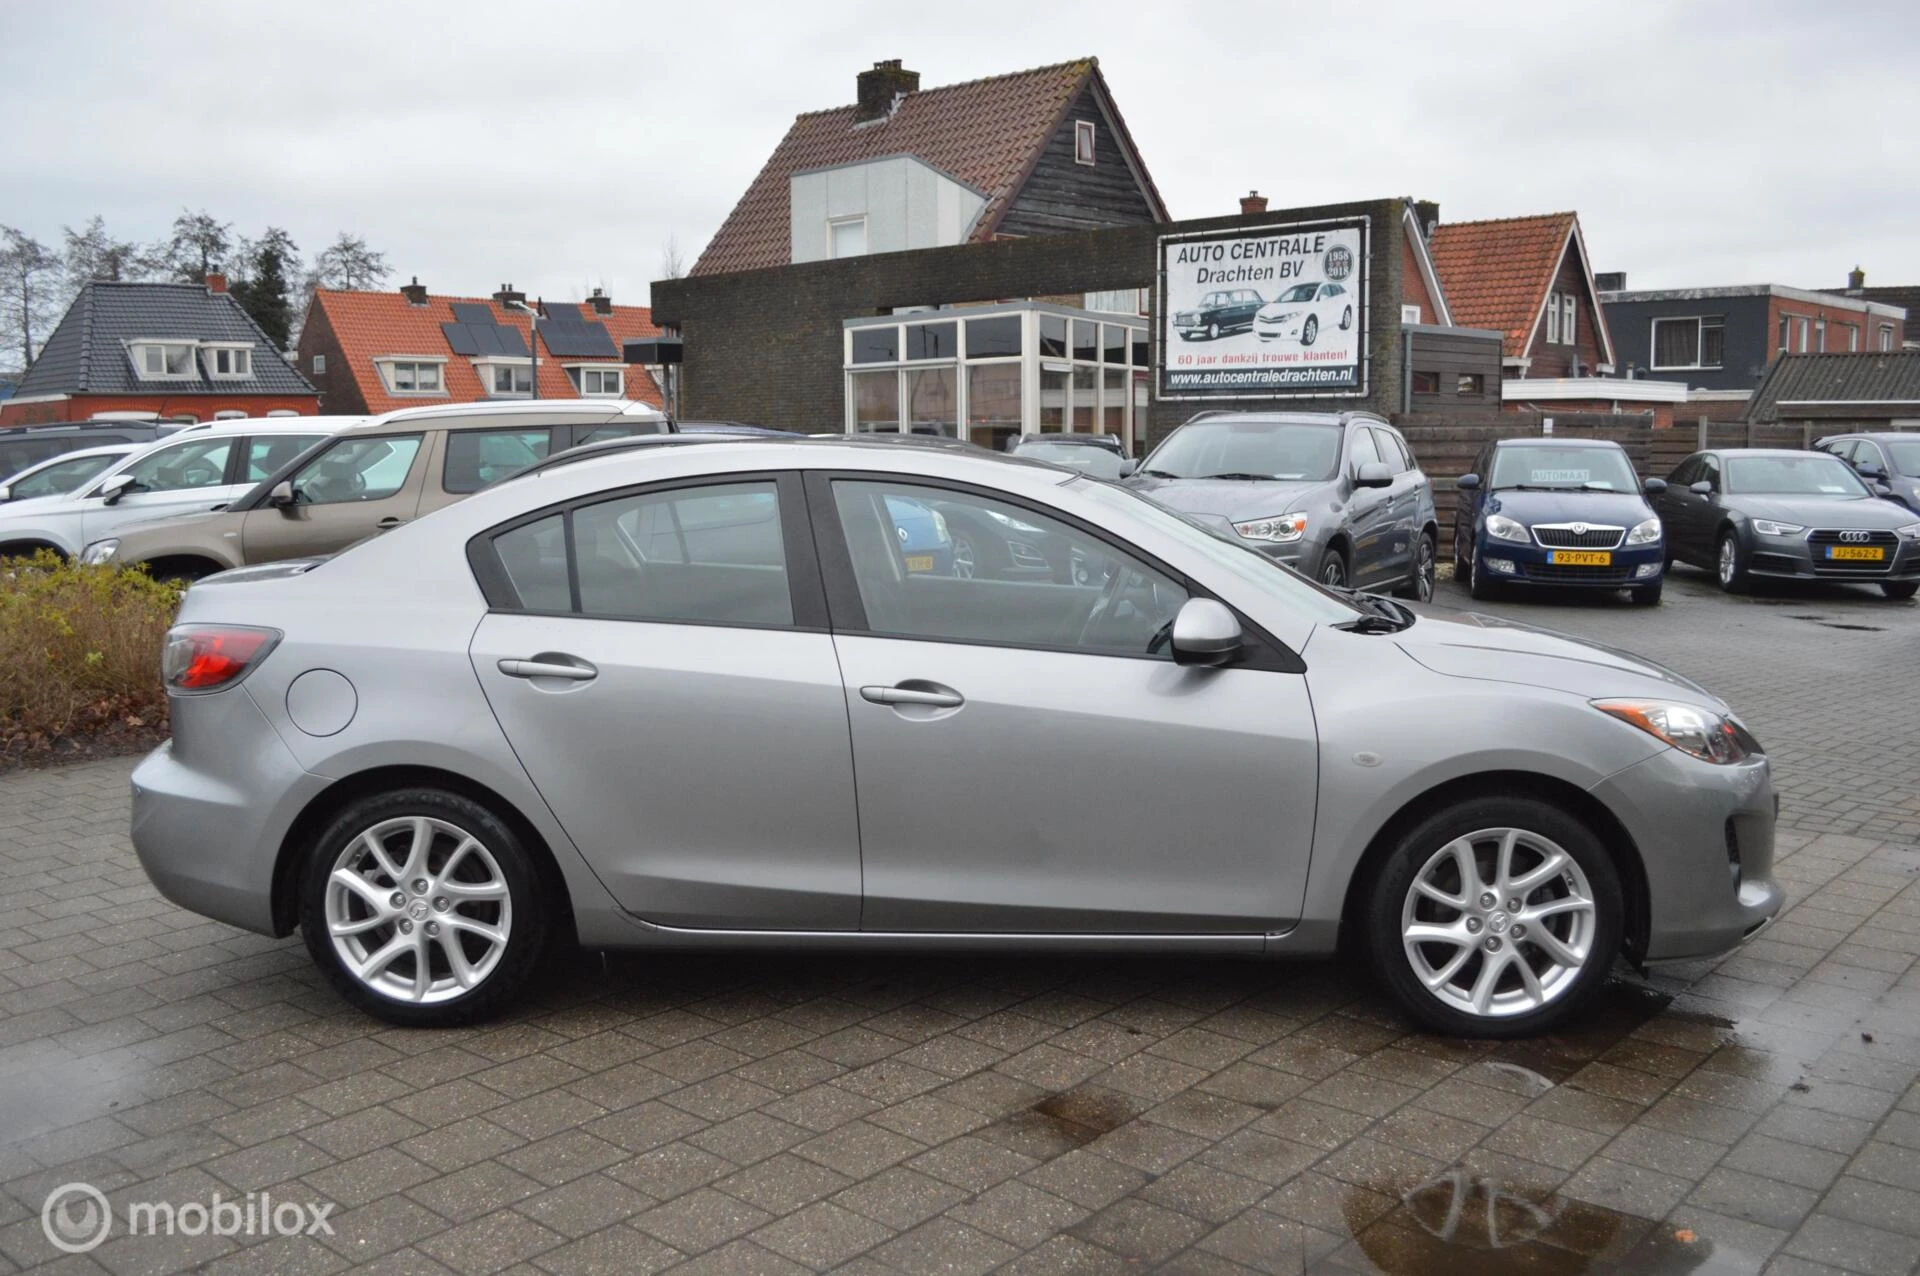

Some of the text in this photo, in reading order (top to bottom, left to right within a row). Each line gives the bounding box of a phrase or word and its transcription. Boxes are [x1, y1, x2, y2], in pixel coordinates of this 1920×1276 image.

[1177, 235, 1326, 264] AUTO CENTRALE
[1328, 251, 1349, 261] 1958
[1196, 260, 1304, 284] Drachten BV
[1197, 353, 1217, 365] jaar
[1222, 352, 1259, 364] dankzij
[1262, 351, 1299, 363] trouwe
[1303, 349, 1348, 361] klanten!
[1170, 367, 1353, 385] www.autocentraledrachten.nl
[1532, 471, 1588, 481] AUTOMAAT
[1557, 553, 1606, 563] 93-PVT-6
